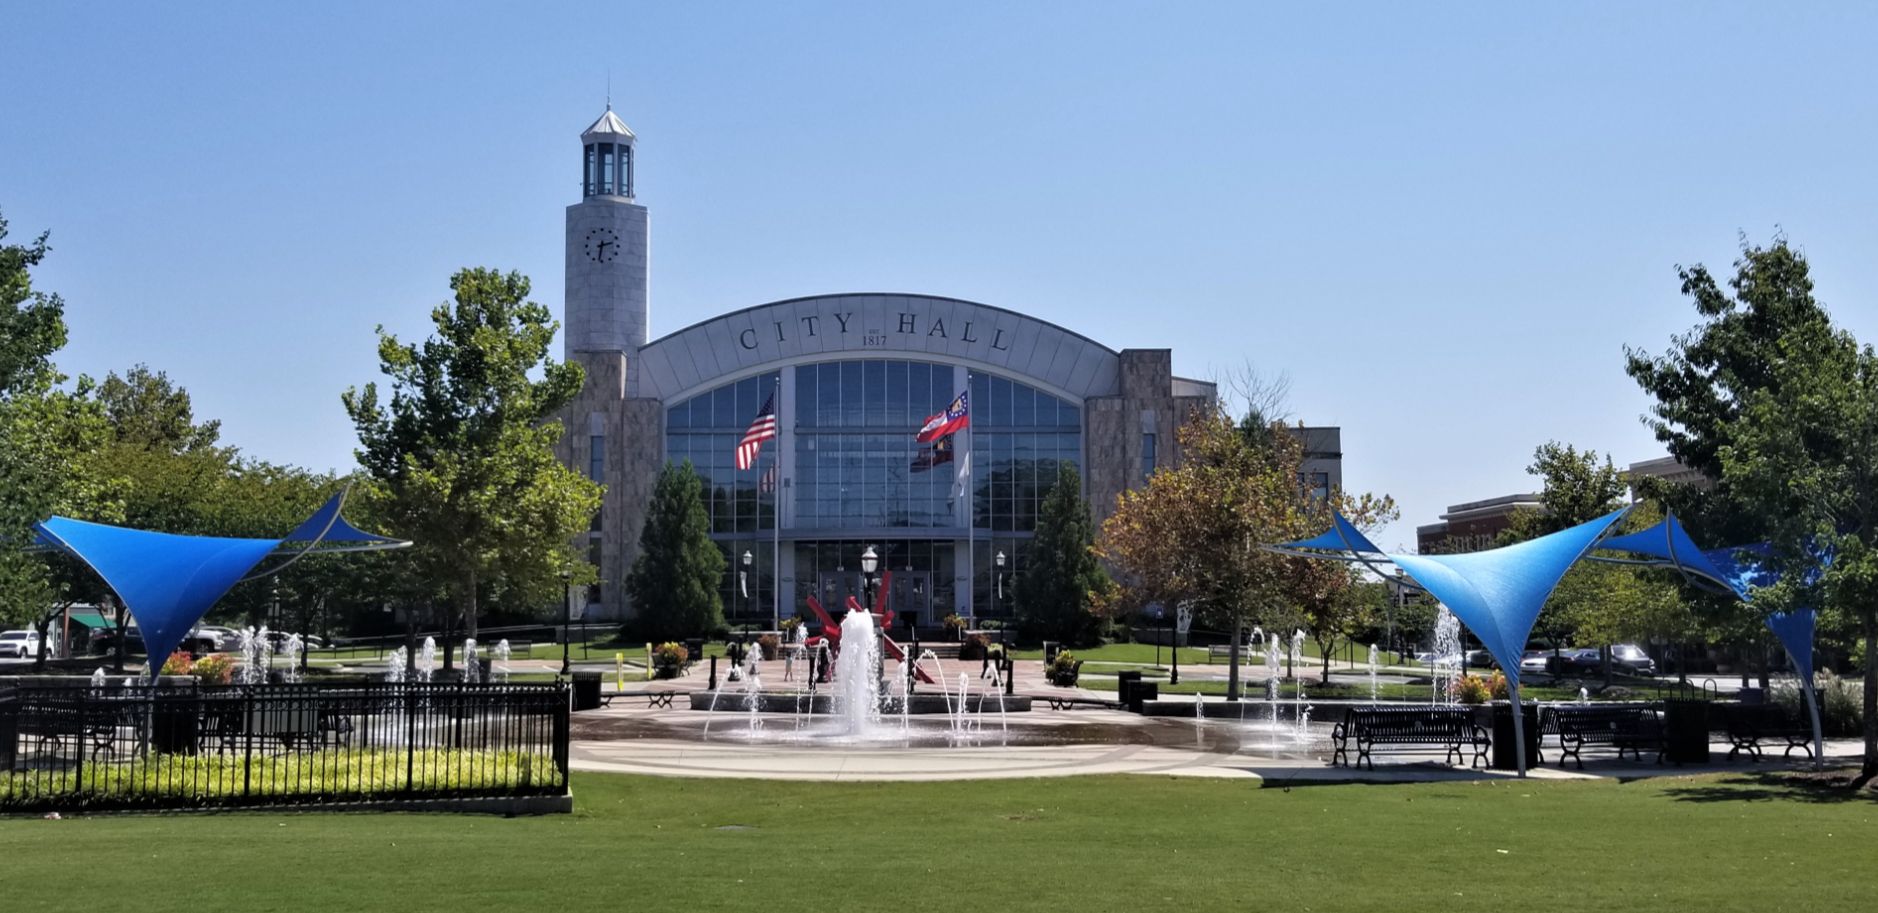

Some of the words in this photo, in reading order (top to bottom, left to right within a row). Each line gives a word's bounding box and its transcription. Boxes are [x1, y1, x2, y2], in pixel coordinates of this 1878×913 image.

[740, 312, 853, 350] CITY
[896, 312, 1009, 351] HALL
[863, 335, 887, 346] 1817
